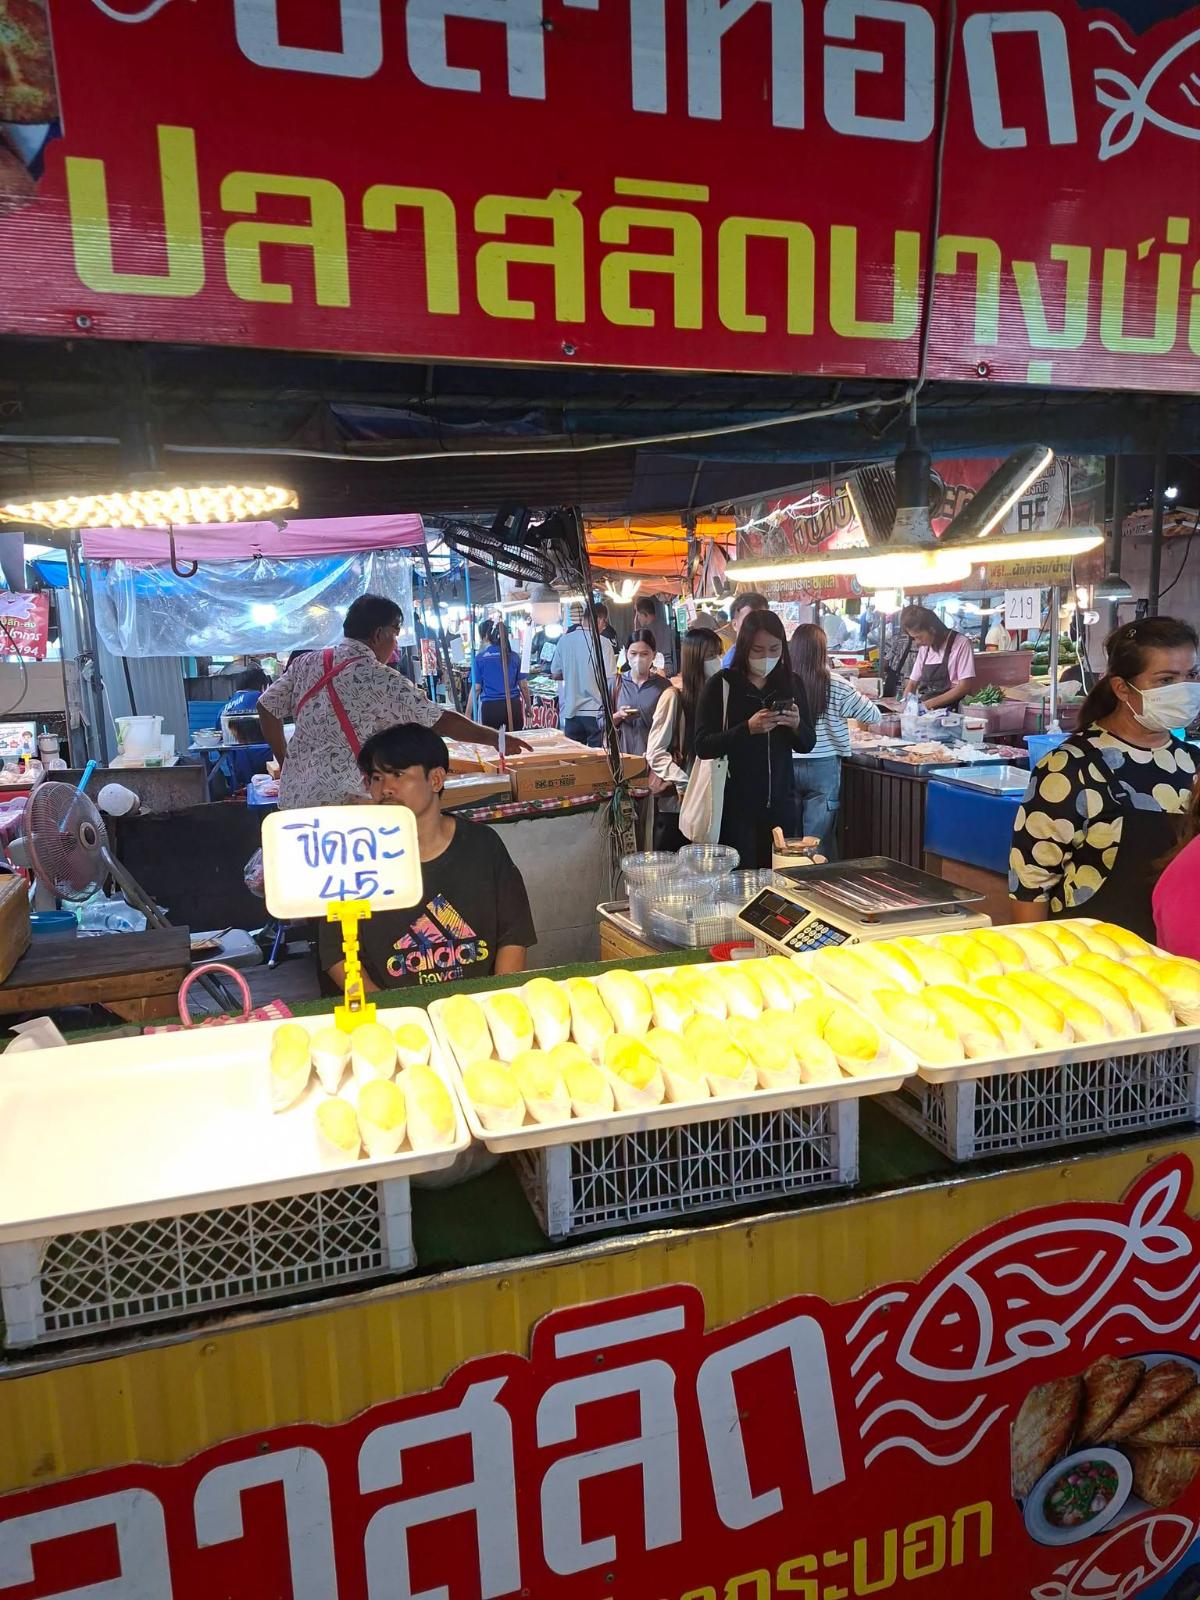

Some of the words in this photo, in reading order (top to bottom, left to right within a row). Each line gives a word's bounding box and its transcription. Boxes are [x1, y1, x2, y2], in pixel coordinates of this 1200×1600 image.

[65, 124, 1200, 355] ปลาสลิดบางบ่
[1009, 596, 1033, 619] 219
[282, 818, 405, 868] ขีดละ
[386, 939, 489, 977] adidas
[418, 966, 464, 984] hawaii
